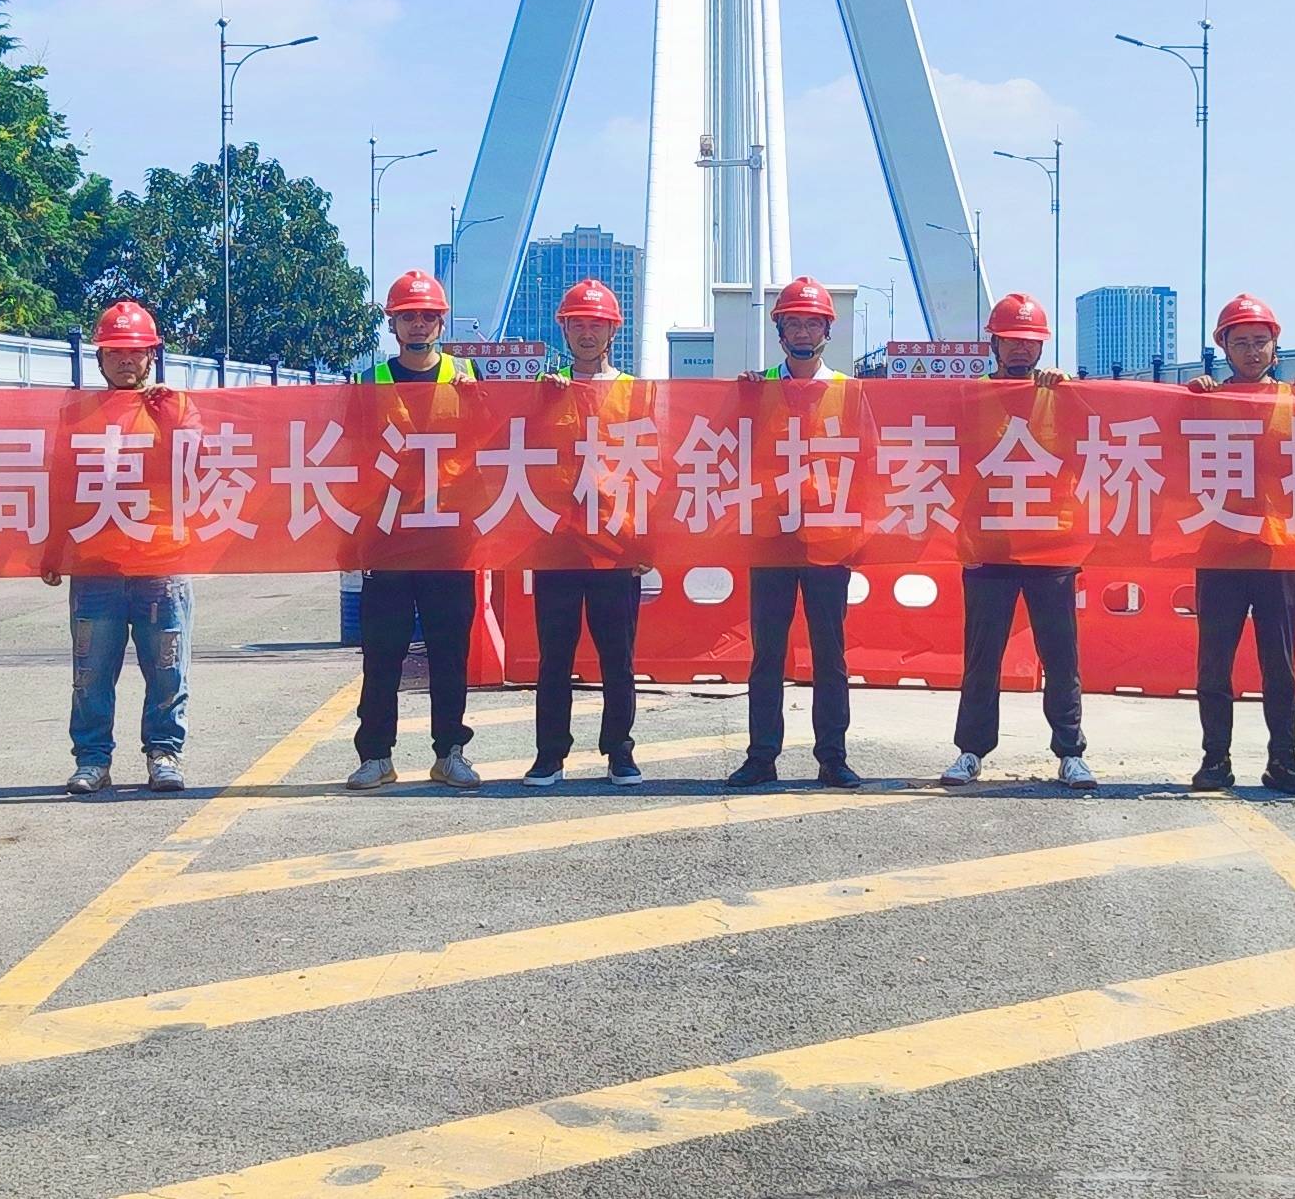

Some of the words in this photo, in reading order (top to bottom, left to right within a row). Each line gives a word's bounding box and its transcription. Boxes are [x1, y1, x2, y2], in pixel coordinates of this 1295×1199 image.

[452, 344, 535, 355] 安全防护通道
[897, 343, 979, 354] 安全防护通道
